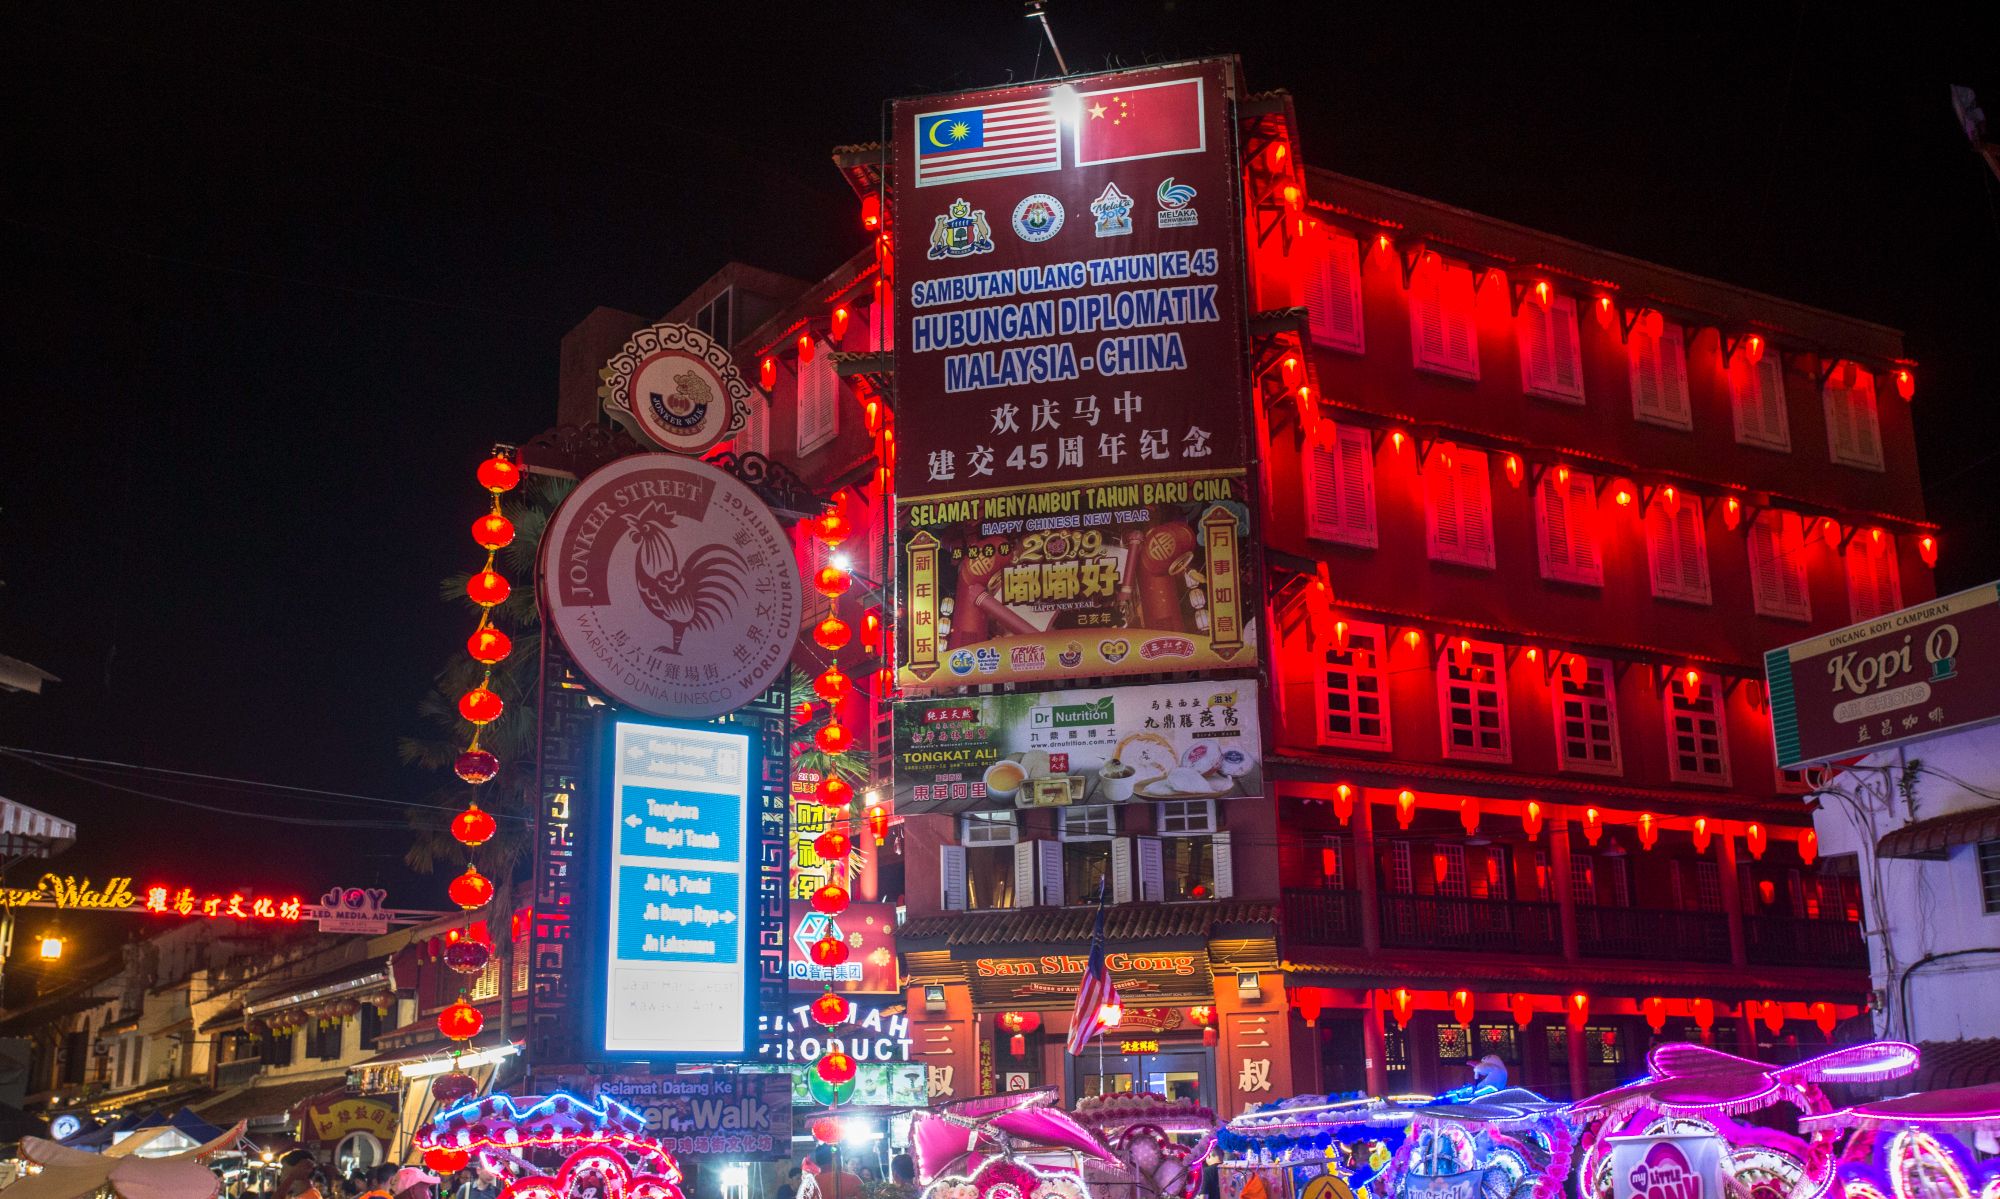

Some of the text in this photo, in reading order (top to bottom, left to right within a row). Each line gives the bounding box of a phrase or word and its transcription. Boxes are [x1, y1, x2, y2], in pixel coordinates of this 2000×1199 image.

[1159, 210, 1196, 219] MELAKA
[913, 249, 1217, 307] SAMBUTAN ULANG TAHUN KE 45
[913, 286, 1218, 351] HUBUNGAN DIPLOMATIK
[946, 343, 1078, 392] MALAYSIA
[1098, 334, 1186, 376] CHINA
[653, 397, 704, 426] JONKER WALK
[990, 391, 1142, 435] 欢庆马中
[927, 426, 1212, 482] 建交45周年纪念
[911, 478, 1232, 526] SELAMAT MENYAMBUT TAHUN BARU CINA
[982, 509, 1150, 535] HAPPY CHINESE NEW YEAR
[570, 479, 703, 598] JONKER STREET
[723, 491, 793, 690] WORLD CULTURAL HERITAGE
[1003, 556, 1120, 604] 嘟嘟好
[1212, 530, 1235, 633] 万事如意
[915, 555, 932, 654] 新年快乐
[1031, 601, 1095, 612] HAPPY NEW YEAR
[1078, 612, 1112, 625] 己亥年
[1830, 603, 1950, 648] UNCANG KOPI CAMPURAN
[577, 613, 733, 705] WARISAN DUNIA UNESCO
[976, 648, 1000, 659] G.L.
[1011, 651, 1046, 664] MELAKA
[1827, 634, 1913, 695] Kopi
[1035, 710, 1108, 724] Dr Nutrition
[902, 748, 997, 763] TONGKAT ALI
[1031, 739, 1118, 748] www.drnutrition.com.my
[798, 773, 819, 781] 2019
[38, 873, 136, 909] Walk
[321, 887, 387, 911] JOY
[976, 958, 1038, 977] San
[1105, 953, 1195, 976] Gong
[602, 1081, 732, 1097] Selamat Datang Ke
[691, 1098, 770, 1130] Walk
[1632, 1172, 1647, 1186] my
